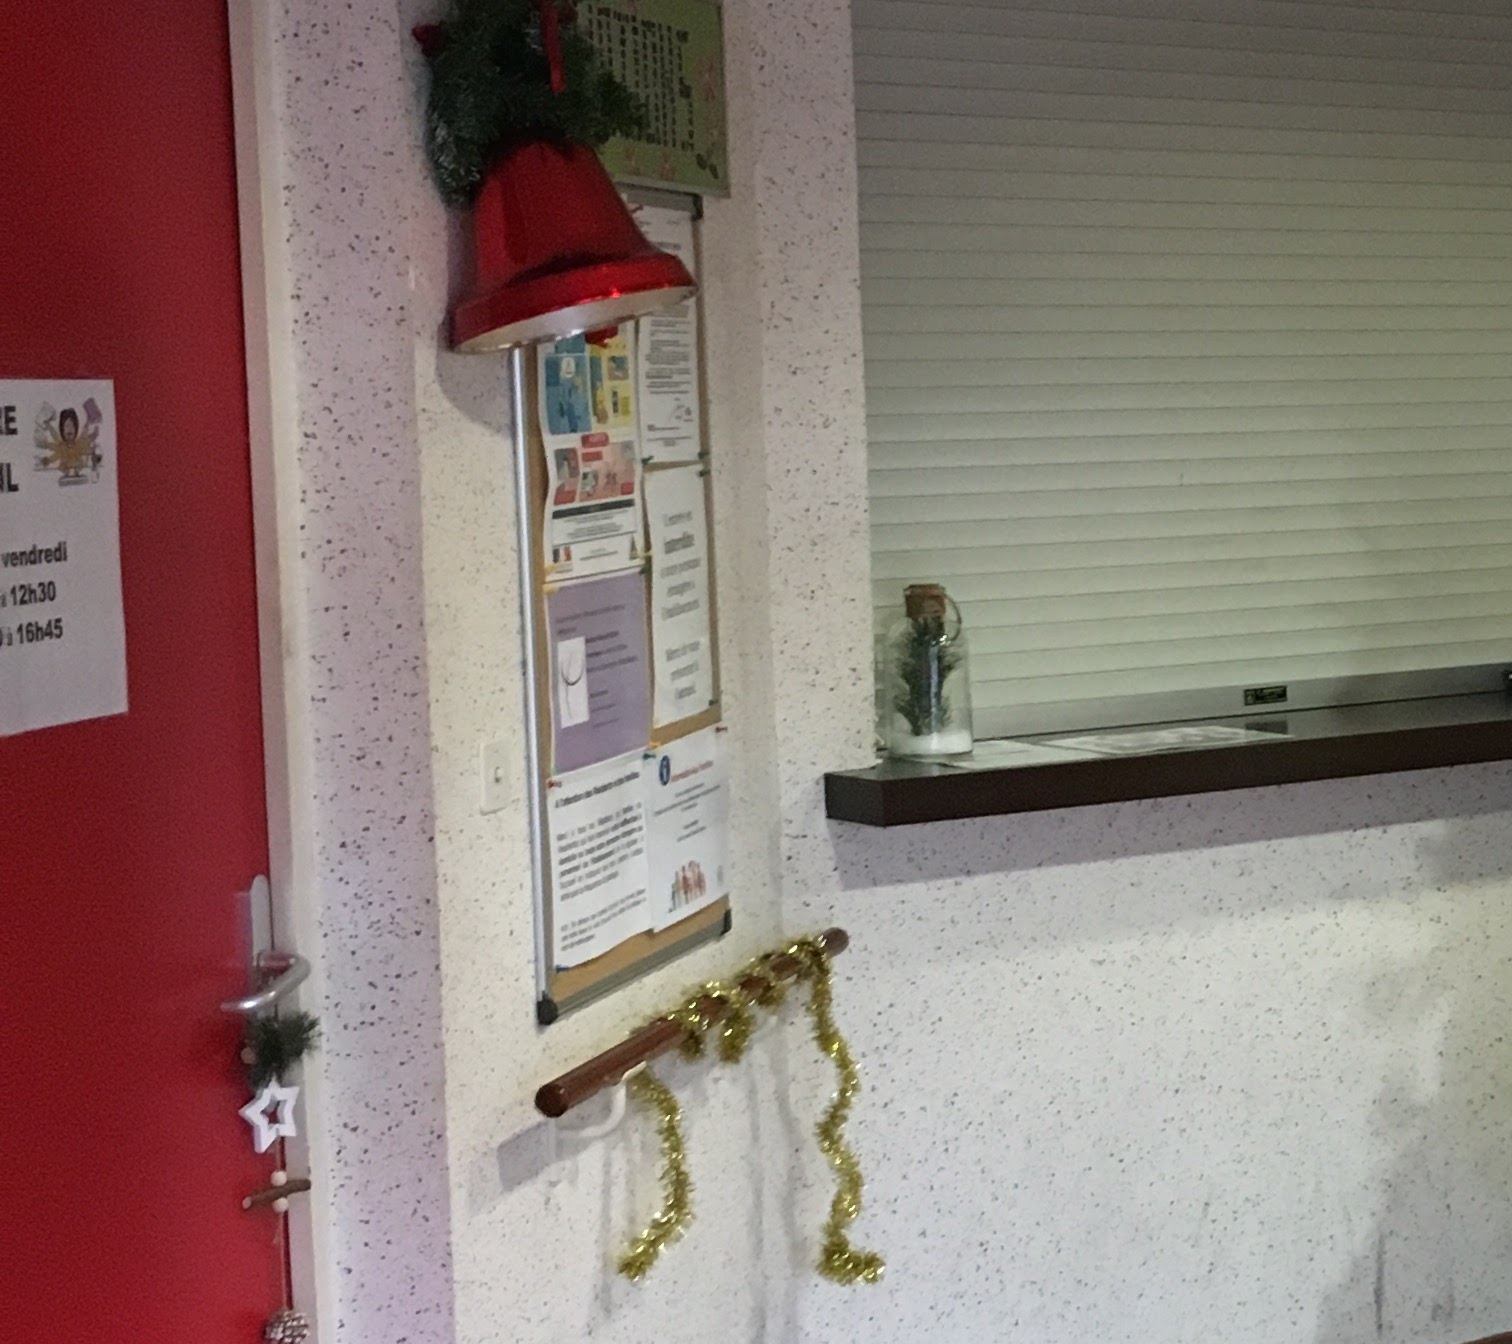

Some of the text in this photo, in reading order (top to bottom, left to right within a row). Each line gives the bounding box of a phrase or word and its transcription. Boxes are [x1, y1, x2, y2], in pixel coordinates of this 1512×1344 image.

[1, 541, 68, 568] vendredi
[10, 580, 56, 606] 12h30
[16, 617, 63, 644] 16h45
